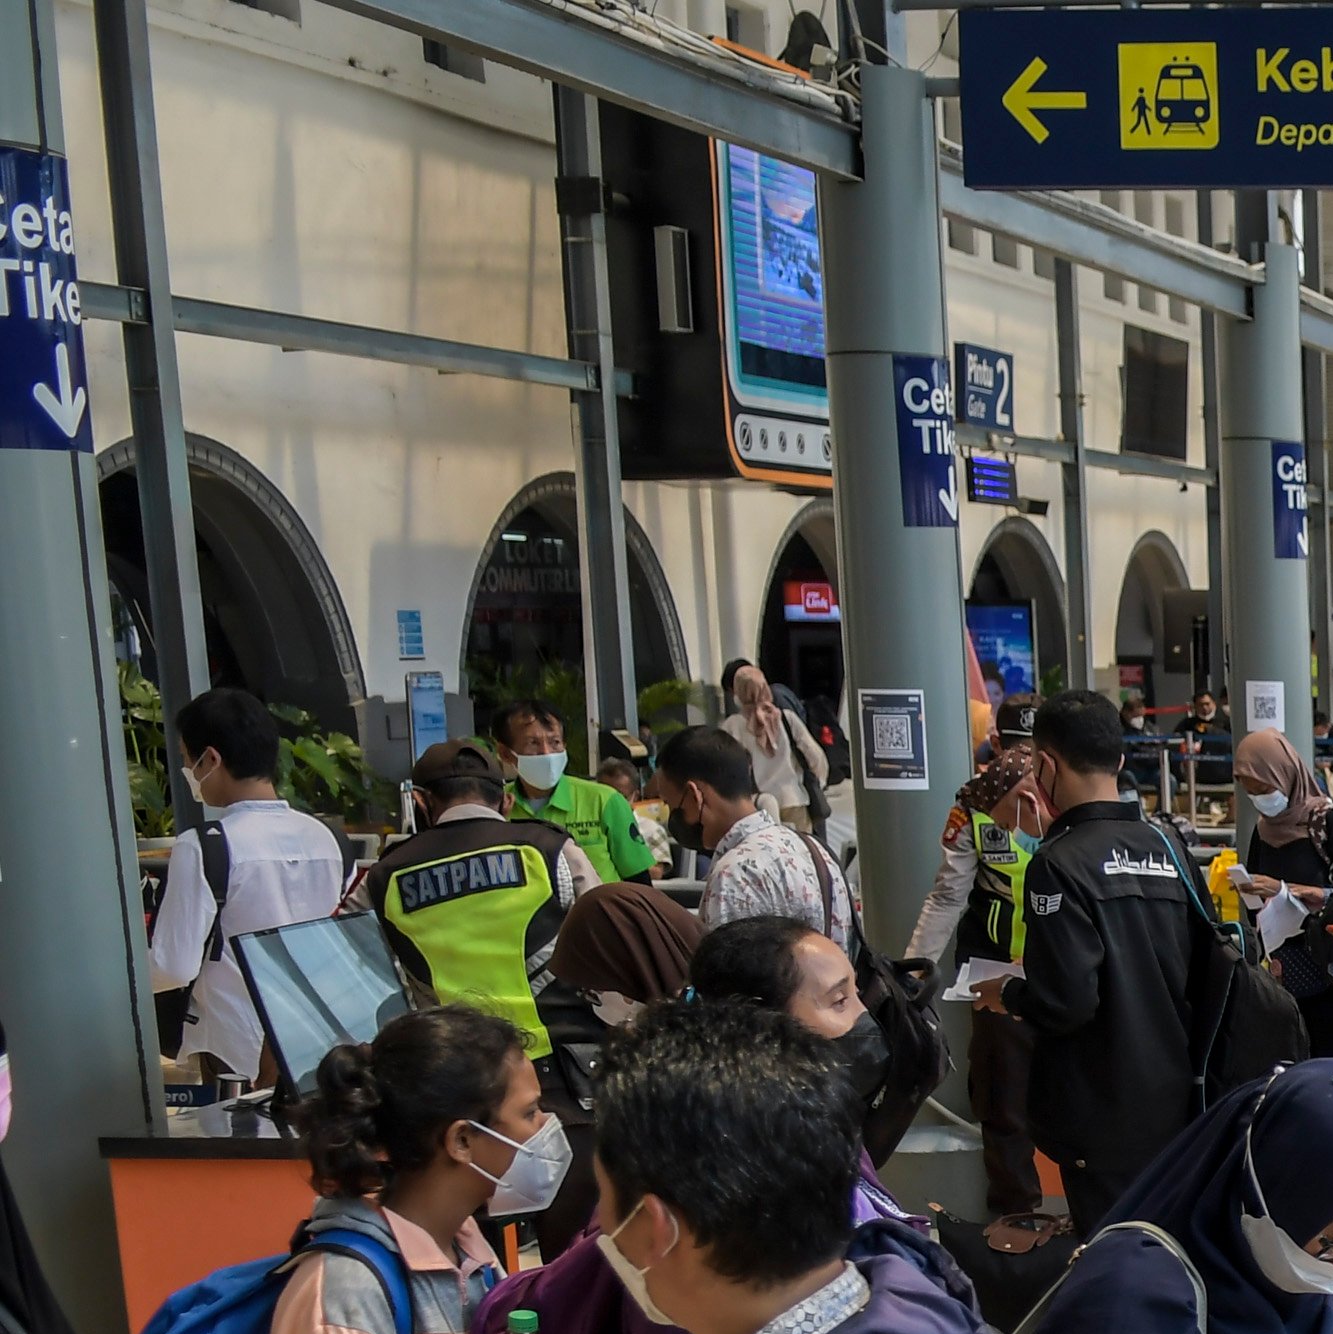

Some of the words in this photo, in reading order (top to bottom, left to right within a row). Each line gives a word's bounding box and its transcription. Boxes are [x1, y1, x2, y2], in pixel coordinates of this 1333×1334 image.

[0, 197, 74, 256] eta
[967, 353, 994, 388] Pintu
[996, 358, 1010, 426] 2
[967, 394, 987, 419] Gate
[505, 541, 563, 562] LOKET
[401, 853, 519, 908] SATPAM
